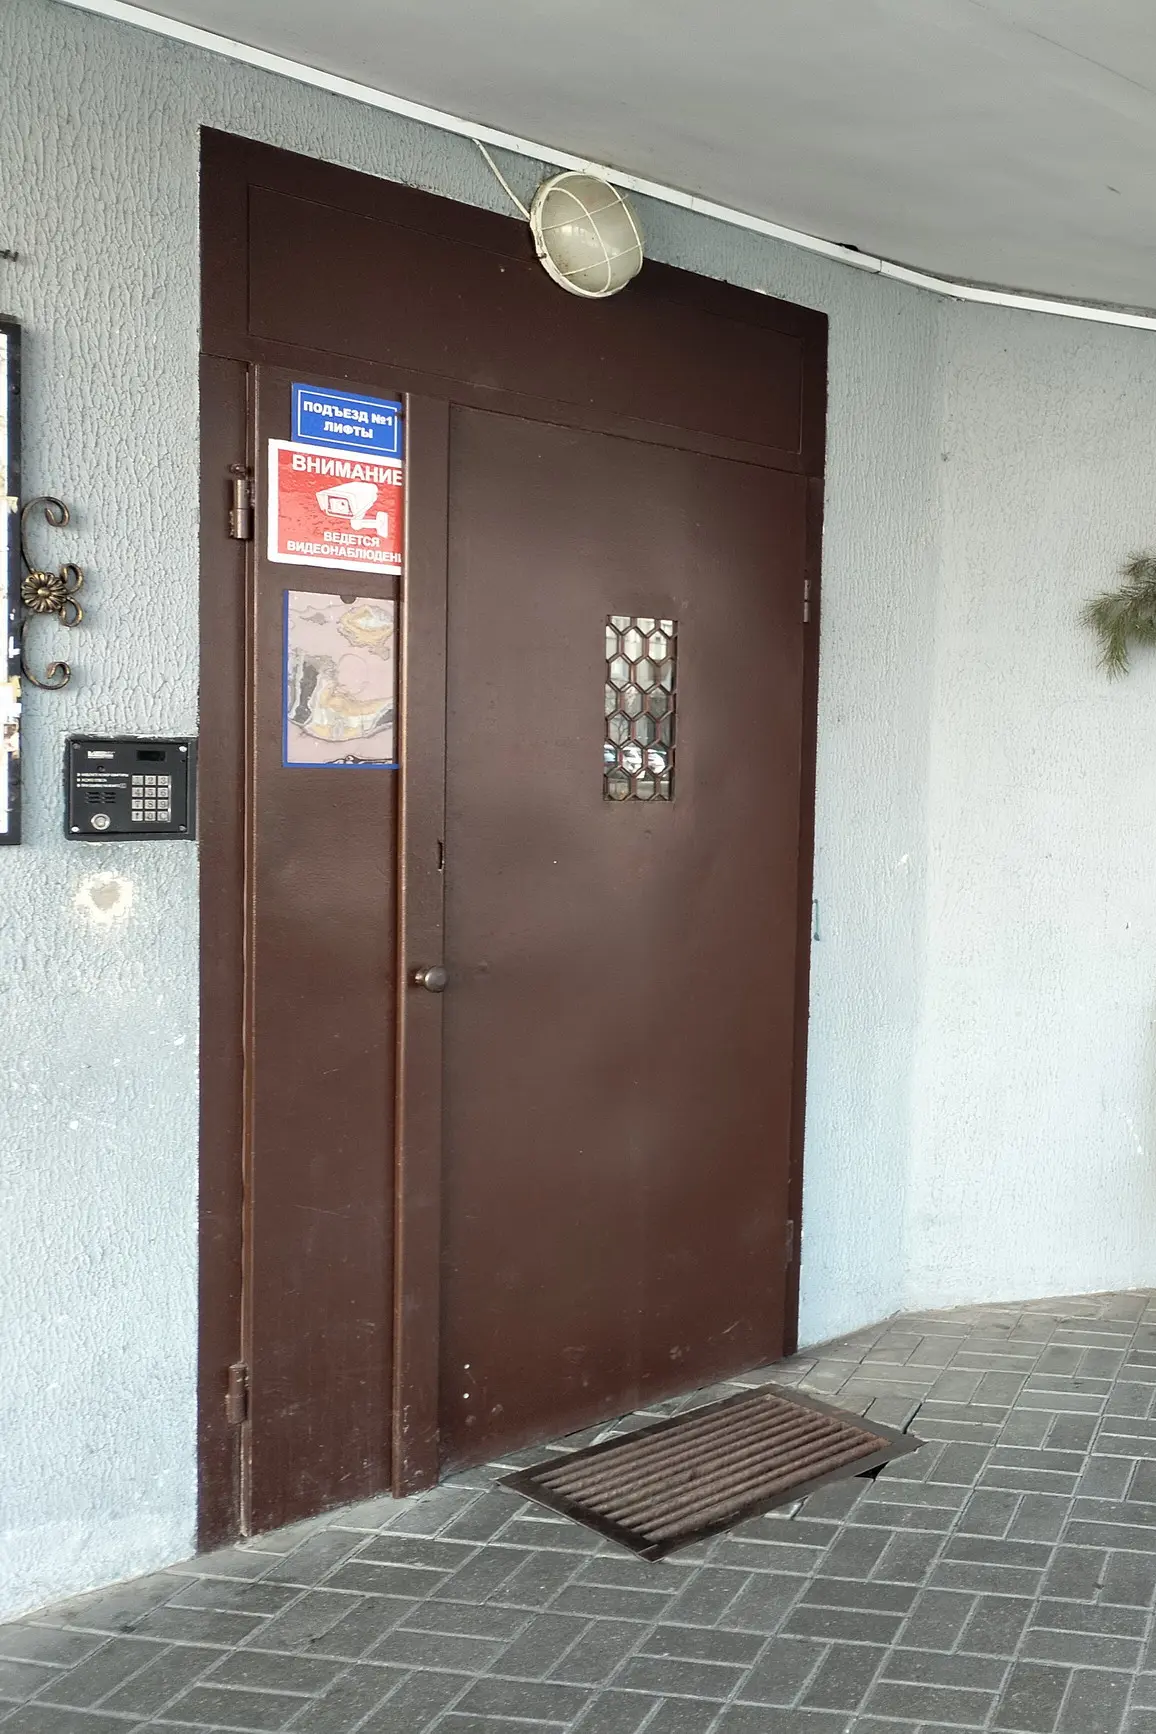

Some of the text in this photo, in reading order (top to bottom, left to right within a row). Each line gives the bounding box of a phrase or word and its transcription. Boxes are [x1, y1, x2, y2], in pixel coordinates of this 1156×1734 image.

[303, 401, 393, 427] ПОДЪЕЗД №1
[323, 421, 374, 439] ЛИФТЫ
[292, 454, 403, 486] ВНИМАНИЕ
[323, 531, 380, 548] ВЕДЕТСЯ
